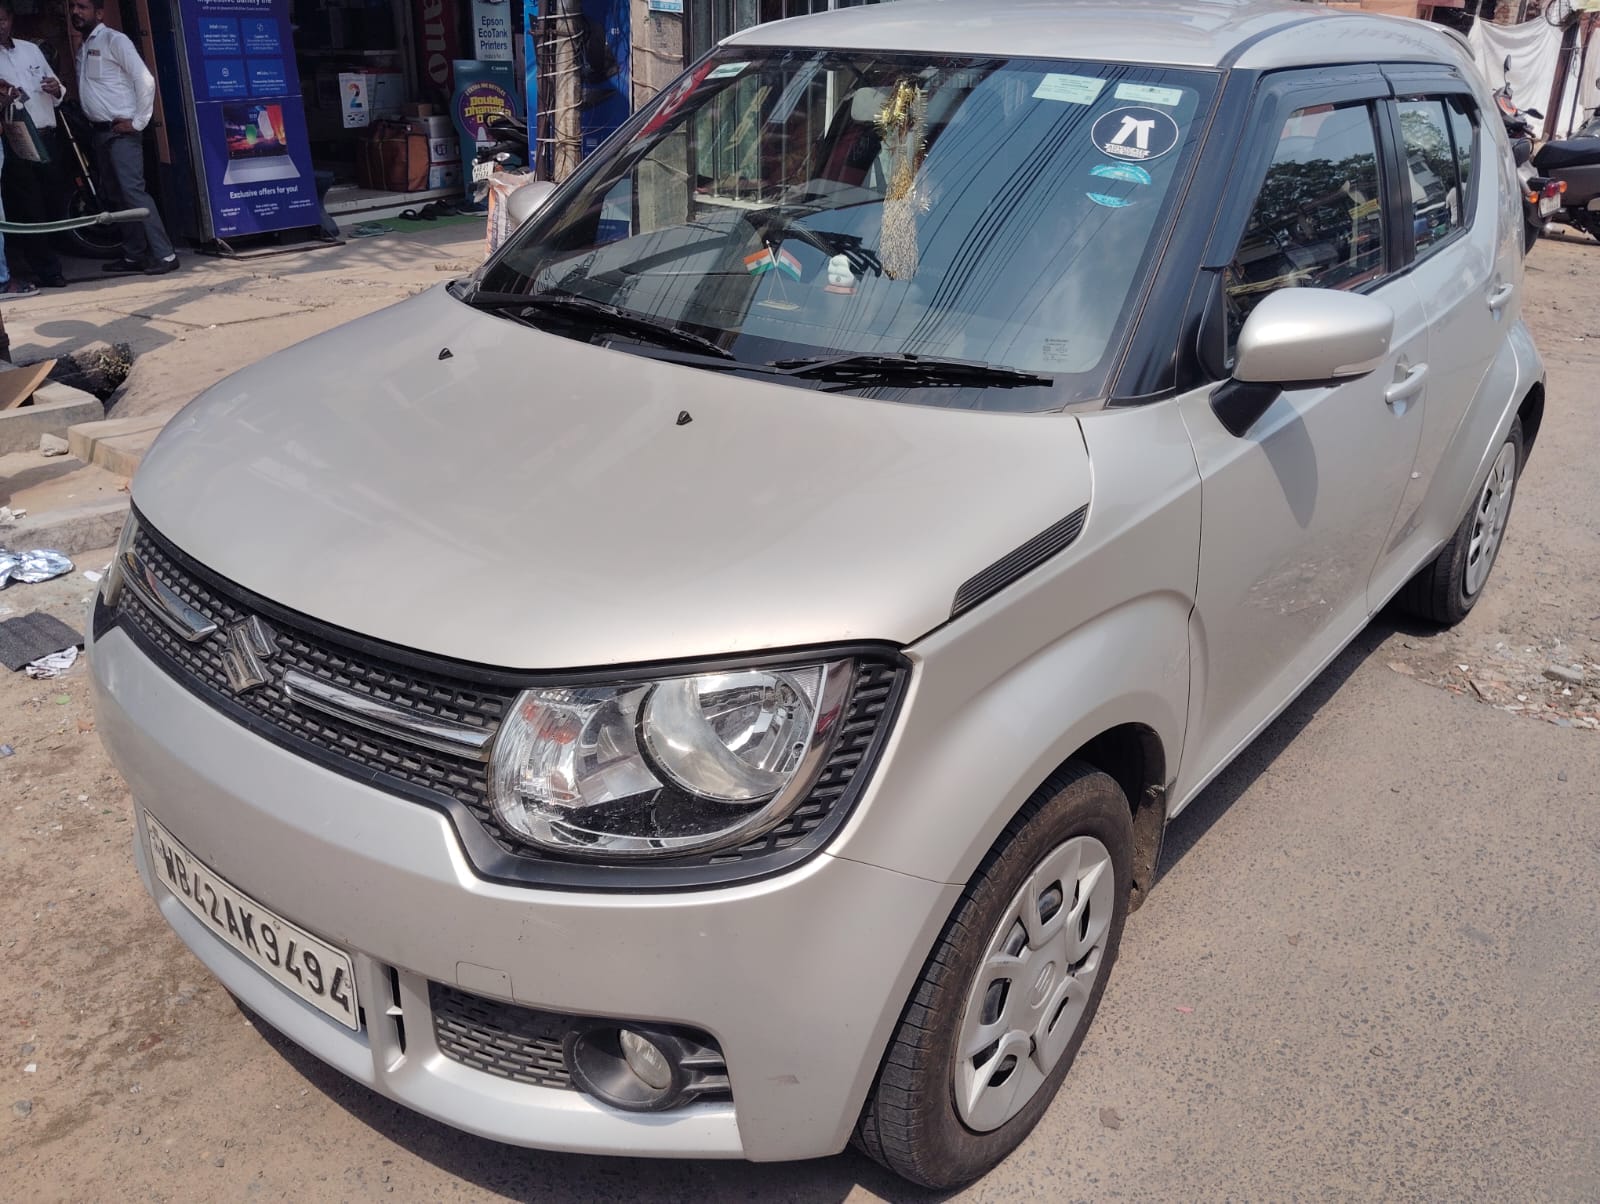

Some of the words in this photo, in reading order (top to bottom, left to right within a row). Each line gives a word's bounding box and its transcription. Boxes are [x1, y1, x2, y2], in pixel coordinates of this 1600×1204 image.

[481, 16, 504, 27] Epson
[478, 28, 508, 38] EcoTank
[480, 40, 508, 50] Printers
[347, 83, 363, 108] 2
[230, 190, 258, 199] Exclusive
[259, 187, 276, 195] offers
[286, 185, 298, 194] you!
[160, 839, 350, 1013] WB42AK9494
